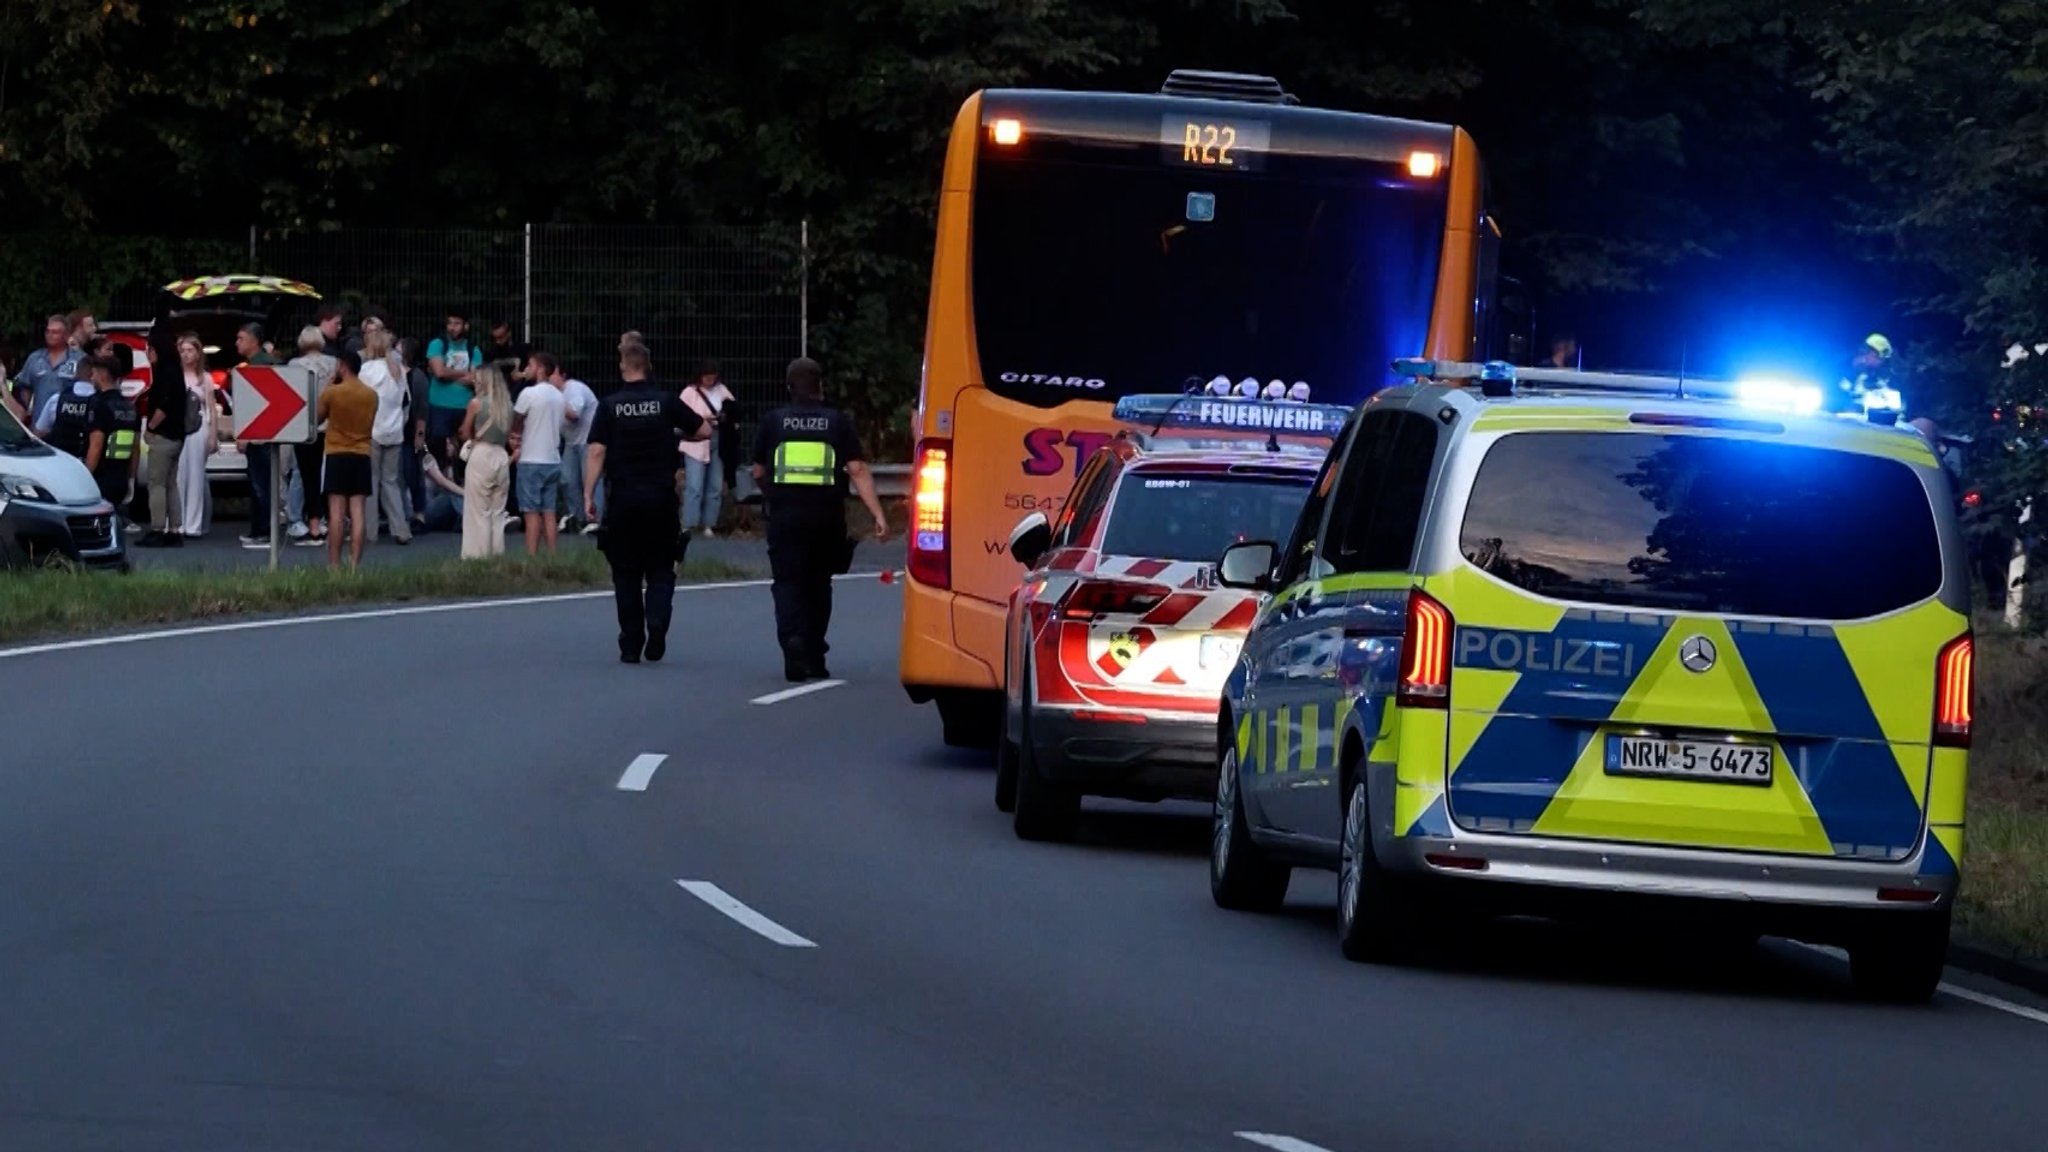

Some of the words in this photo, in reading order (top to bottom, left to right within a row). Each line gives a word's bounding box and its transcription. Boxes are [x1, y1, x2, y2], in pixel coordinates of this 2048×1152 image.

[1184, 123, 1235, 165] R22
[1000, 372, 1106, 389] CITARO
[615, 401, 661, 417] POLIZEI
[783, 417, 829, 430] POLIZEI
[1200, 402, 1323, 431] FEUERWEHR
[1459, 629, 1634, 678] POLIZEI
[1622, 742, 1668, 768] NRW
[1682, 746, 1769, 776] 5-6473
